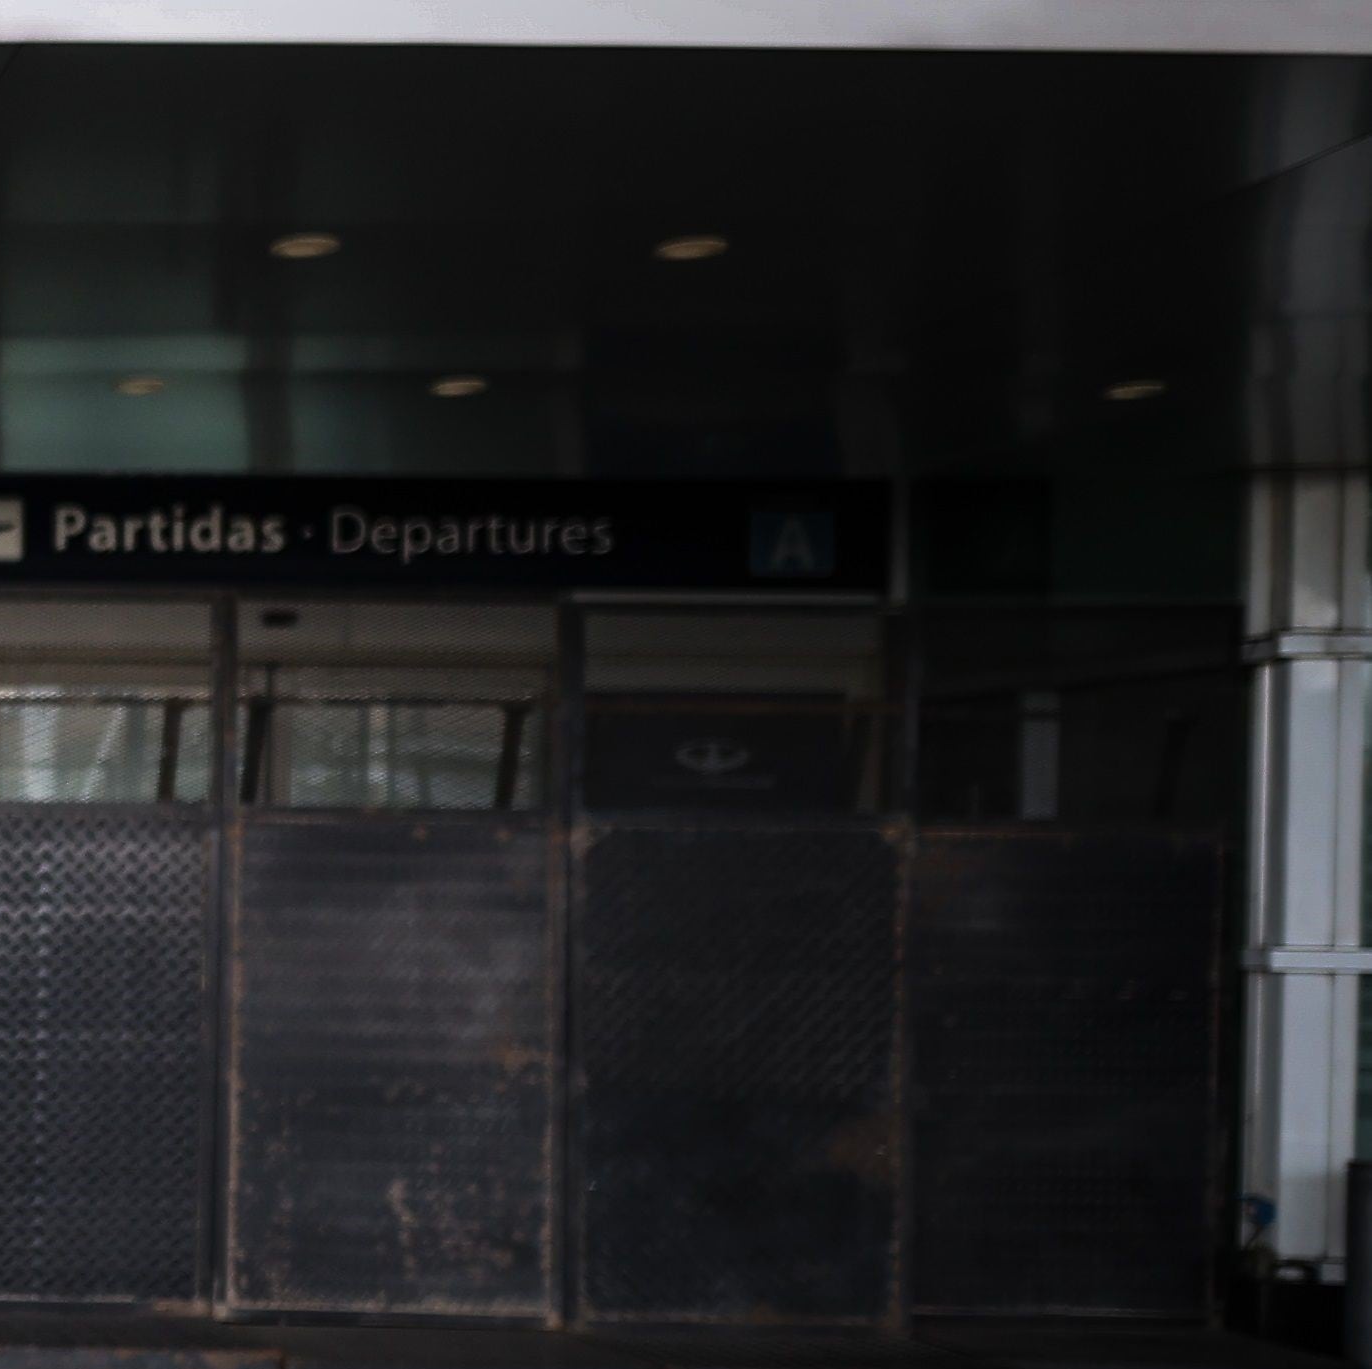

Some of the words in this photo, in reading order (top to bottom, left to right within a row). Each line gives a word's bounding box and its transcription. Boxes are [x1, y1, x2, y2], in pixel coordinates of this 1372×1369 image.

[53, 505, 284, 552] Partidas
[329, 507, 612, 565] Departures
[770, 517, 815, 573] A
